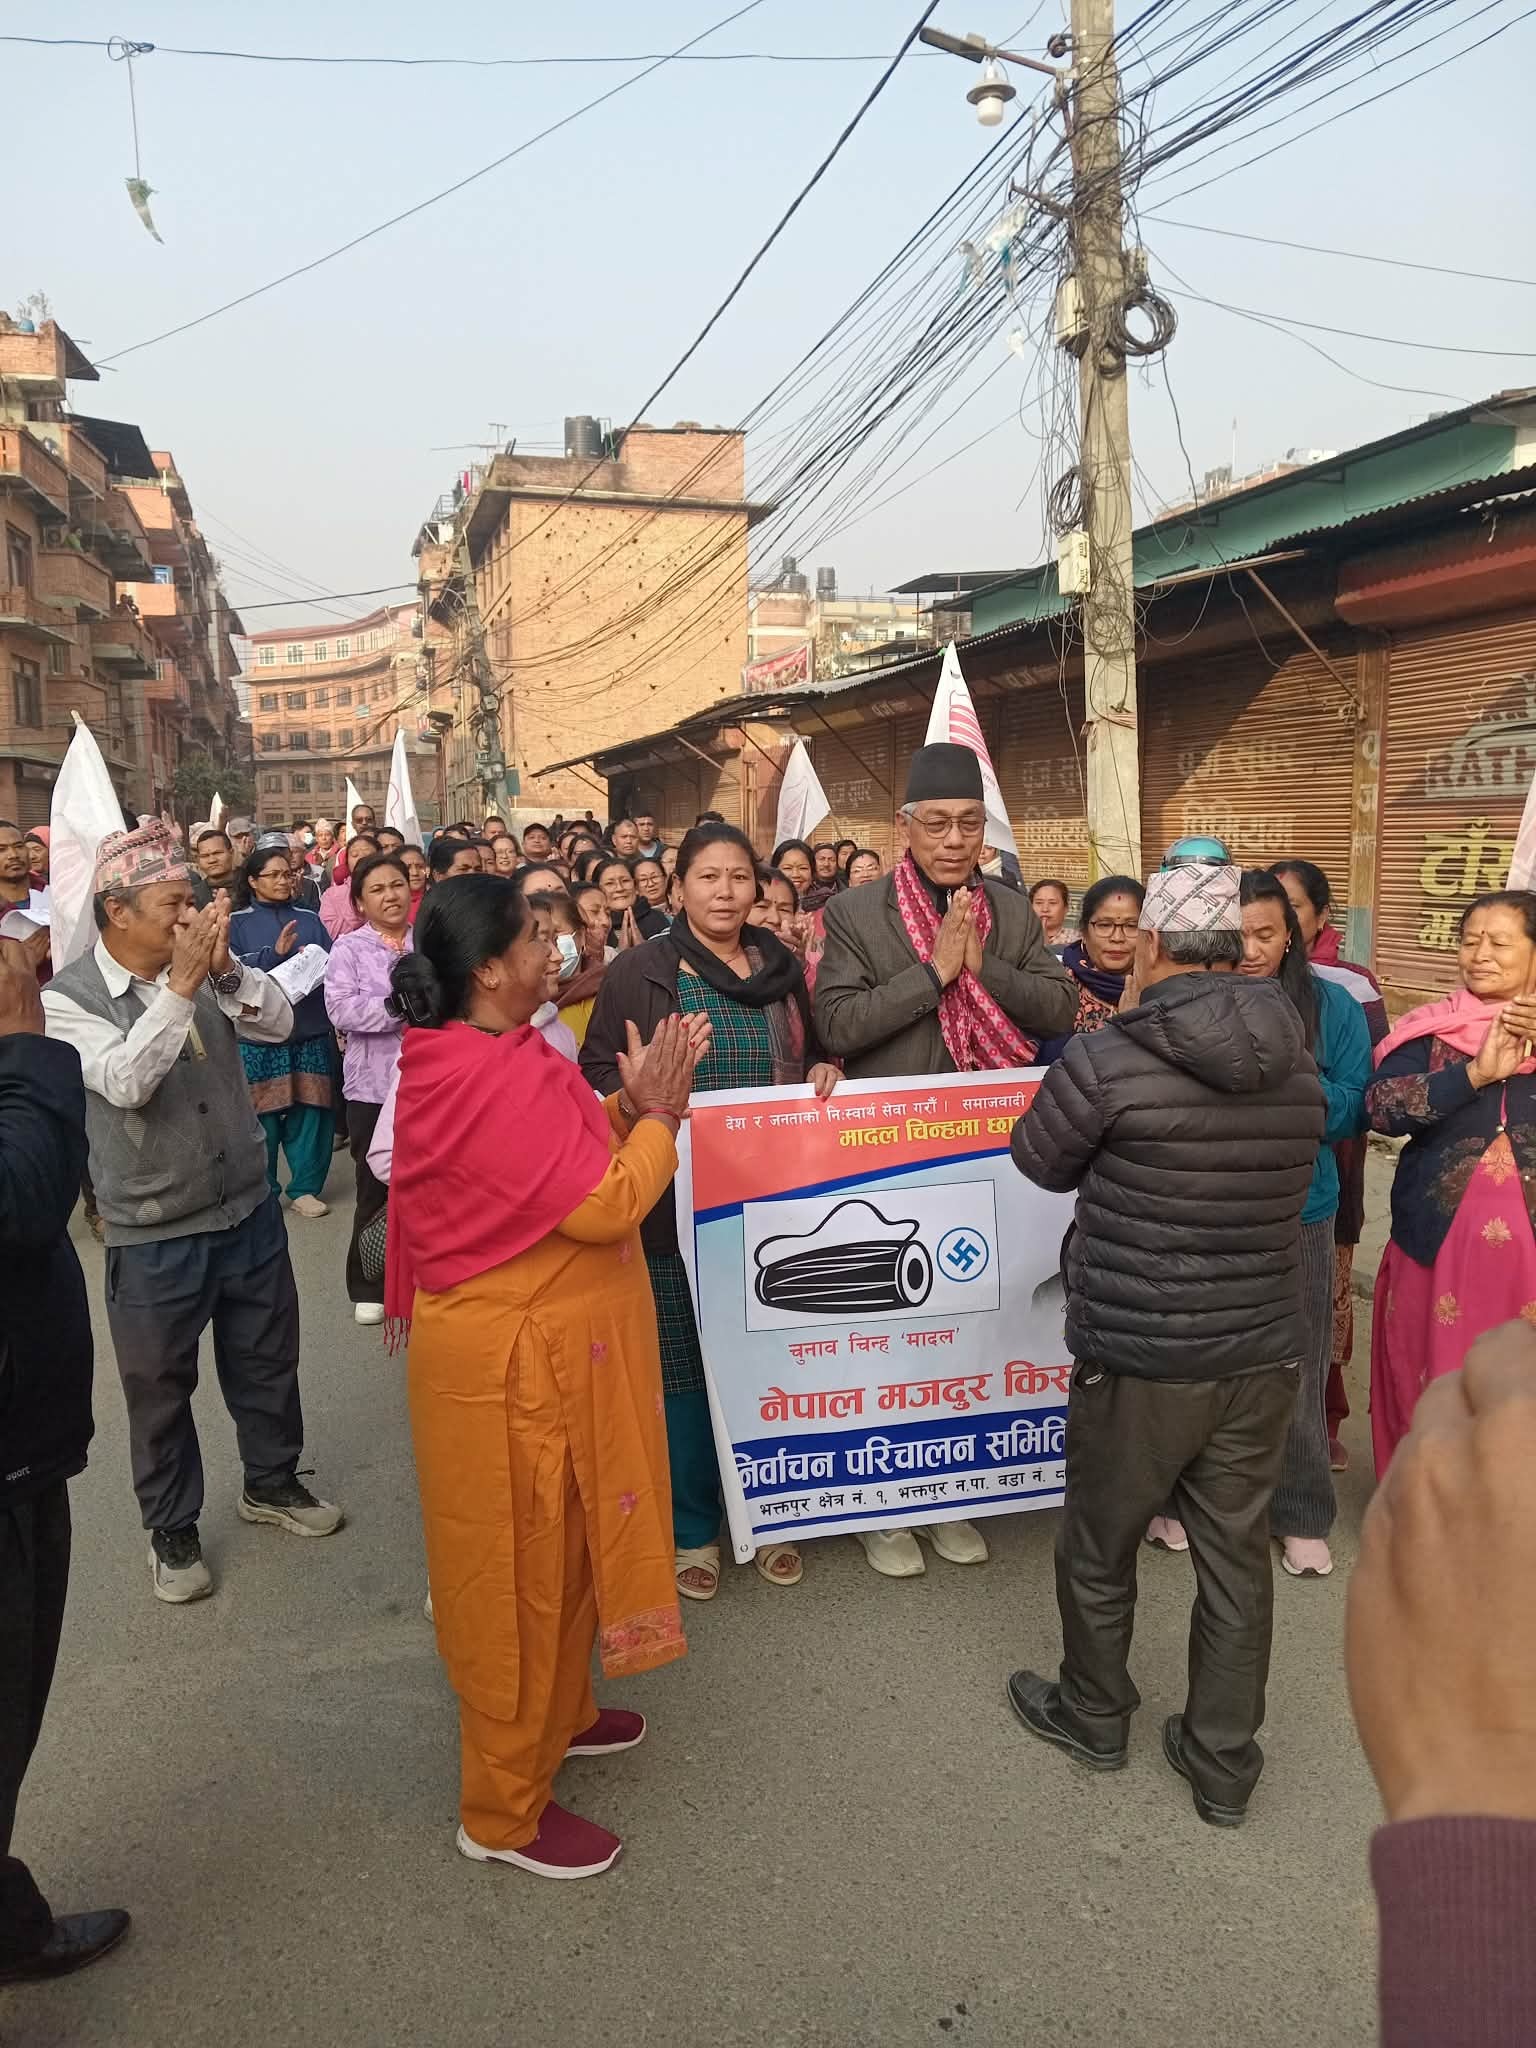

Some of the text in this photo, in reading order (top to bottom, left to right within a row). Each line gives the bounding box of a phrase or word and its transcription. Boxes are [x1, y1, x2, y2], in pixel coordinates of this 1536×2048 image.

[725, 1115, 747, 1131] देश
[752, 1116, 763, 1129] र
[769, 1109, 820, 1127] जनताको
[881, 1102, 907, 1118] सेवा
[962, 1091, 1027, 1111] समाजवादी
[839, 1115, 1022, 1146] मादल चिन्हमा छा
[788, 1339, 838, 1365] चुनाव
[848, 1331, 890, 1353] चिन्ह
[759, 1360, 1073, 1423] नेपाल मजदुर किस
[845, 1434, 977, 1476] परिचालन
[759, 1497, 810, 1517] भक्तपुर
[819, 1493, 844, 1509] क्षेत्र
[852, 1490, 867, 1505] नं.
[898, 1481, 948, 1501] भक्तपुर
[955, 1477, 990, 1492] न.पा.
[998, 1472, 1025, 1487] वडा
[1032, 1467, 1046, 1482] नं.
